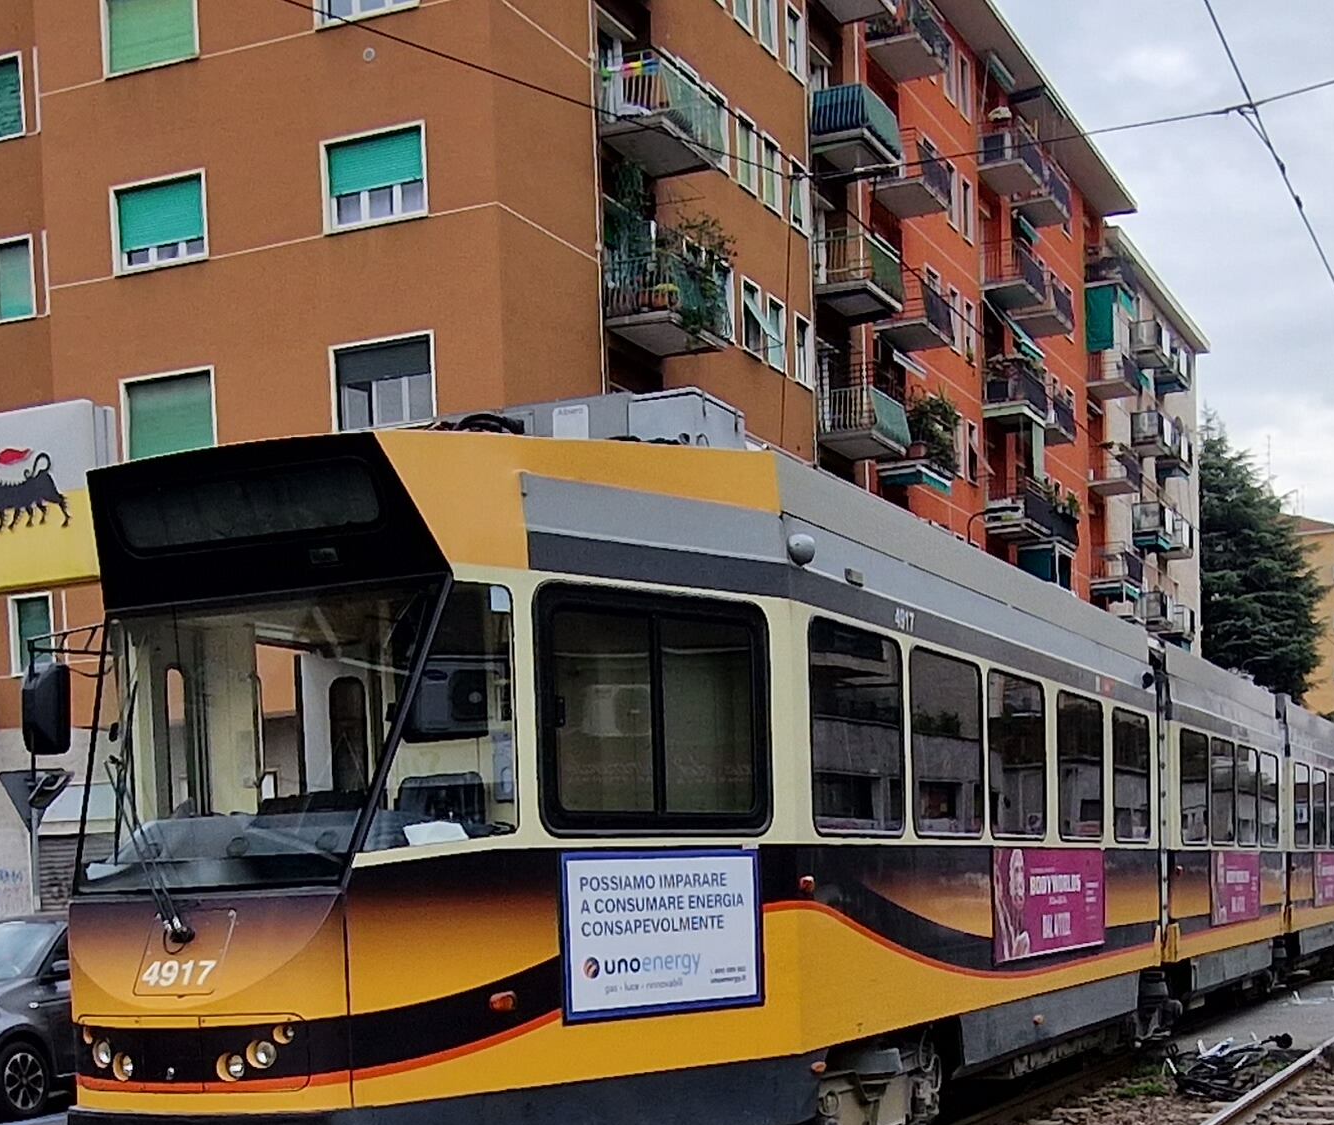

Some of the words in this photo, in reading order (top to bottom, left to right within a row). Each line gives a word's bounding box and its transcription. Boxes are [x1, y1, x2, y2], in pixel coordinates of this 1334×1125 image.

[895, 608, 915, 633] 4917
[580, 874, 656, 892] POSSIAMO
[659, 872, 727, 890] IMPARARE
[581, 899, 591, 914] A
[594, 895, 684, 914] CONSUMARE
[688, 893, 744, 910] ENERGIA
[581, 914, 725, 937] CONSAPEVOLMENTE
[142, 959, 217, 986] 4917
[604, 952, 701, 975] unoenergy
